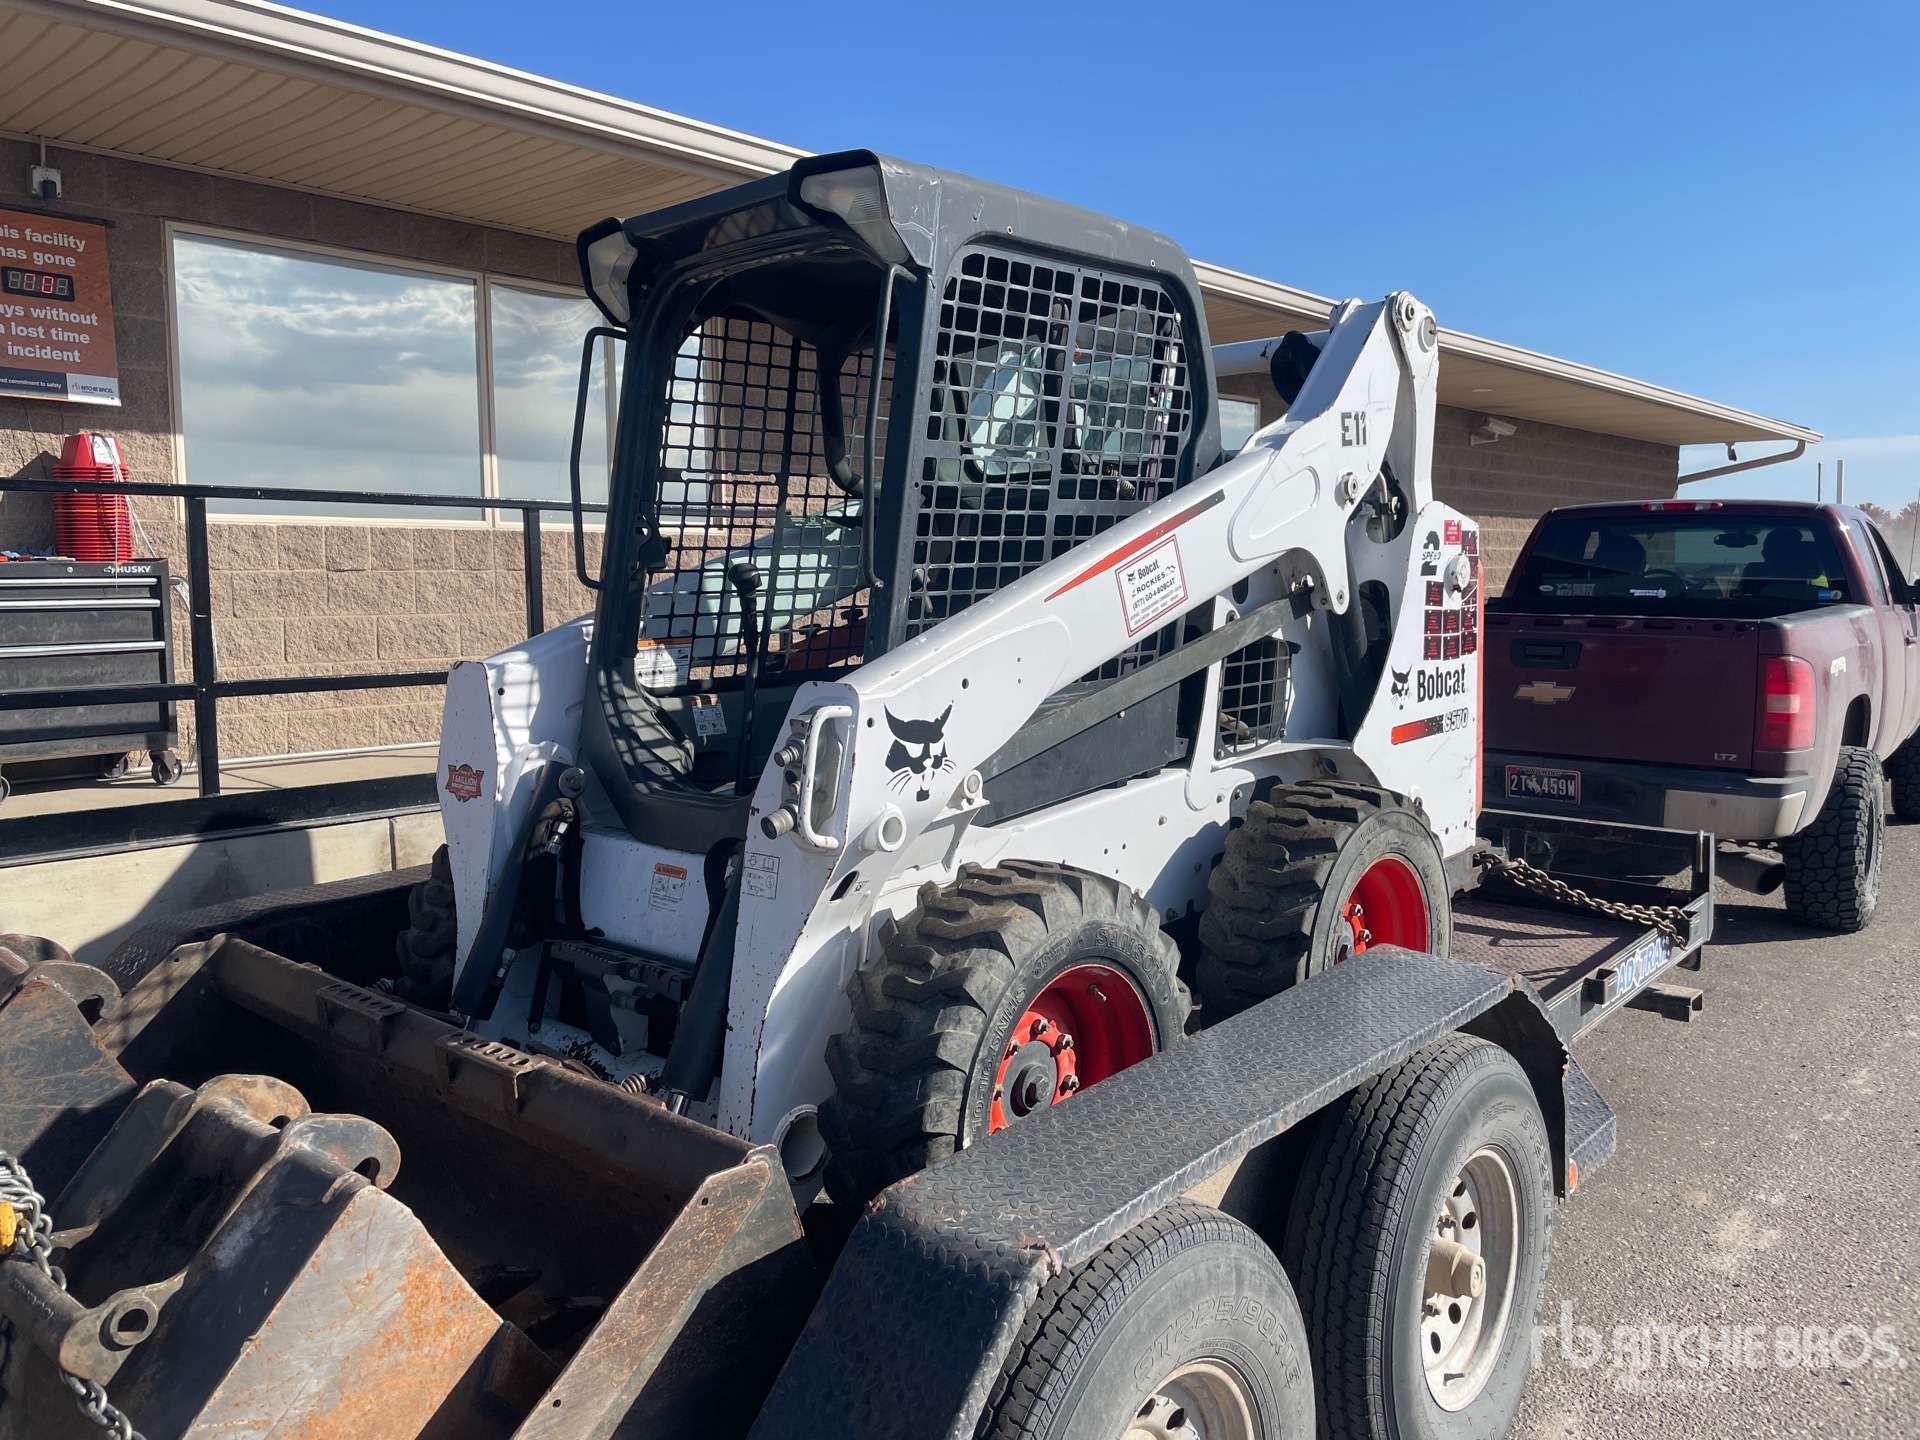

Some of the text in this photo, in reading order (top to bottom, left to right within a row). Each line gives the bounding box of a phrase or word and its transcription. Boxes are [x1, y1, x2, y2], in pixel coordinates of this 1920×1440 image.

[25, 228, 86, 252] facility
[33, 251, 76, 267] gone
[30, 306, 98, 326] without
[11, 322, 45, 338] lost
[50, 328, 90, 344] time
[8, 342, 81, 362] incident
[1341, 411, 1367, 446] E11
[116, 565, 151, 573] HUSKY
[1137, 559, 1160, 580] Bobcat
[1136, 571, 1166, 594] ROCKIES
[1133, 596, 1146, 611] (877)
[1417, 663, 1466, 702] Bobcat
[1444, 707, 1469, 732] S570
[1714, 752, 1738, 762] LTZ
